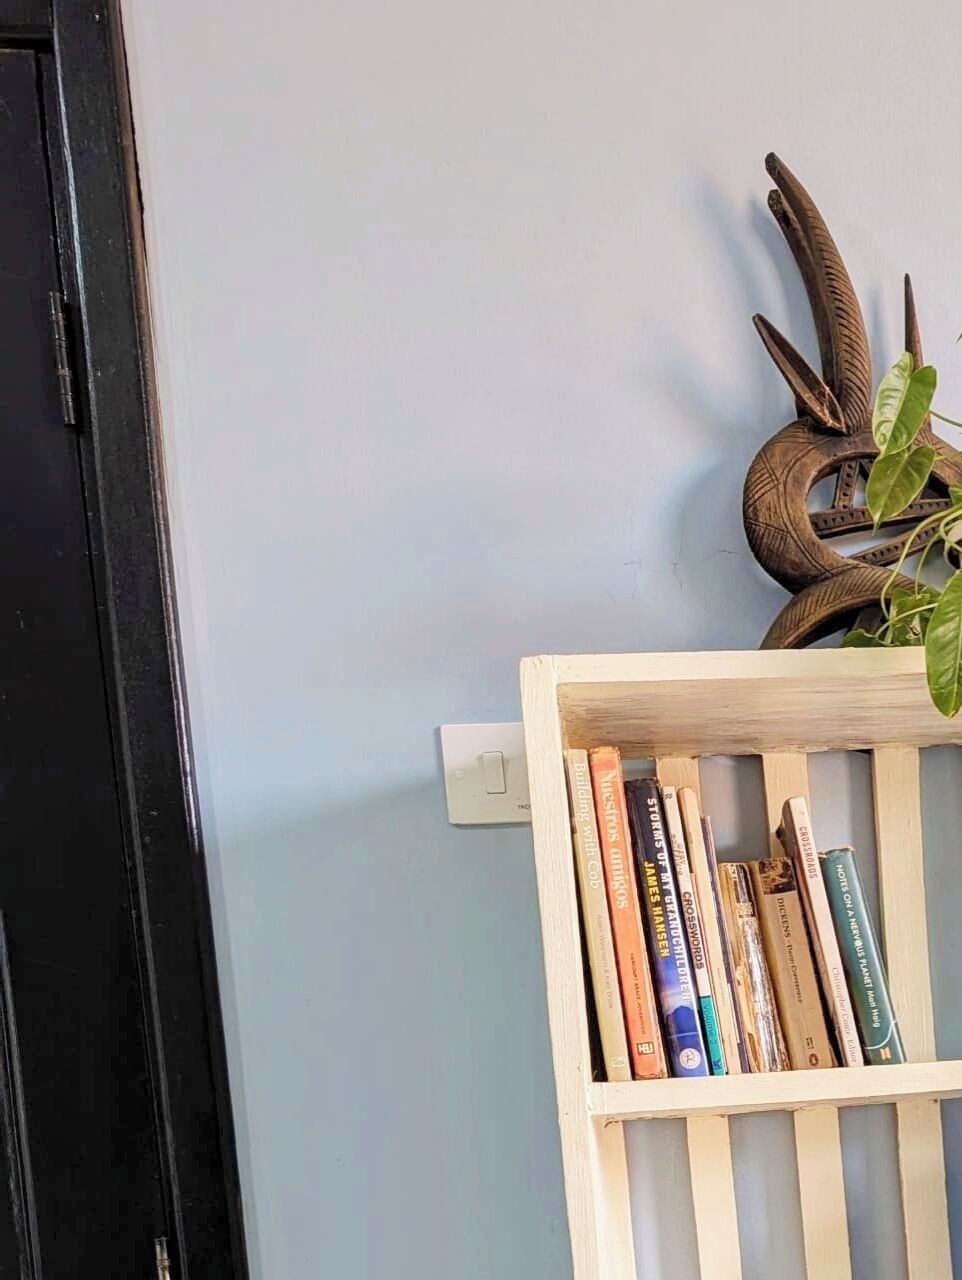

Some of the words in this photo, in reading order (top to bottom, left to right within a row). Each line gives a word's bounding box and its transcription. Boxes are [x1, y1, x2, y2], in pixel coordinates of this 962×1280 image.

[571, 761, 592, 821] Building
[599, 770, 619, 842] Nuestros
[581, 824, 597, 857] with
[647, 797, 665, 848] STORMS
[656, 851, 667, 868] OF
[798, 825, 817, 879] CROSSROADS
[586, 860, 600, 889] Cob
[608, 847, 629, 909] amigos
[643, 860, 660, 903] JAMES
[660, 871, 672, 890] MY
[835, 863, 849, 892] NOTES
[776, 897, 791, 938] DICKENS
[842, 892, 853, 908] ON
[651, 906, 670, 957] HANSEN
[663, 893, 692, 1001] GRANDCHILDREN
[681, 890, 705, 970] CROSSWORDS
[848, 917, 865, 957] NERVOUS
[858, 958, 873, 988] PLANET
[831, 966, 847, 1012] Christopher
[845, 1038, 859, 1063] Editor
[865, 989, 877, 1008] Matt
[868, 1008, 882, 1028] Haig
[702, 1003, 715, 1035] Volume
